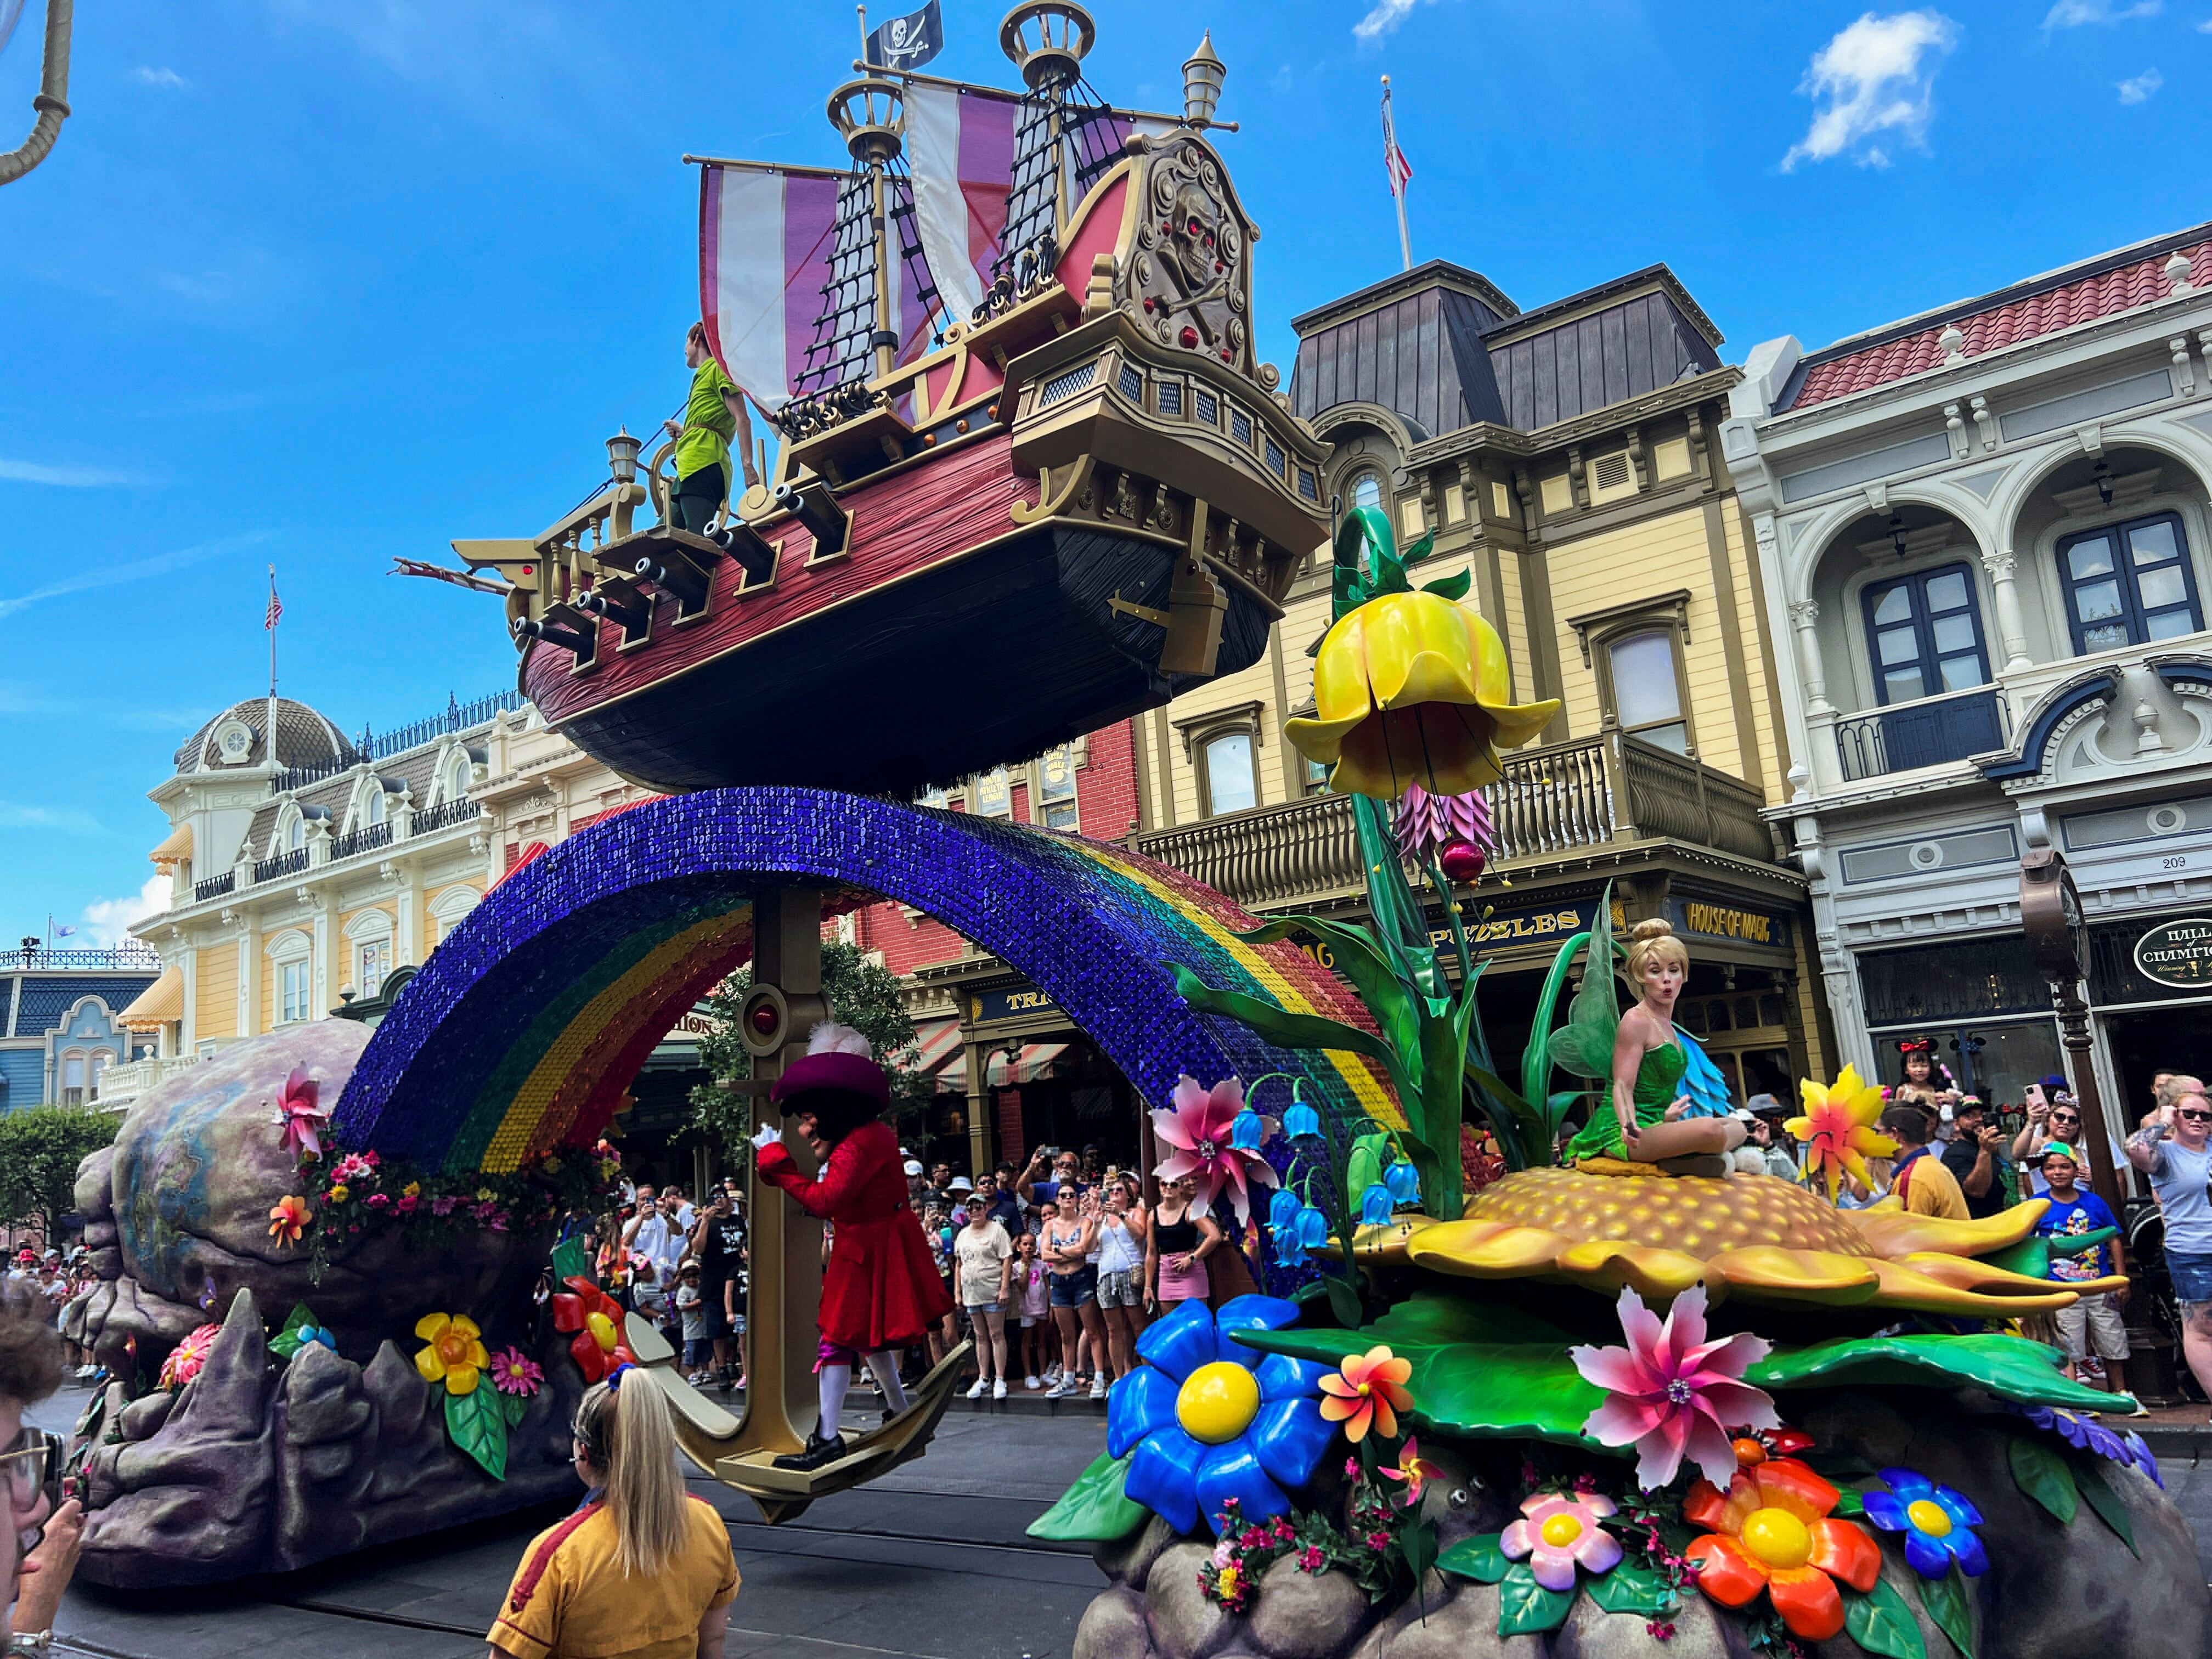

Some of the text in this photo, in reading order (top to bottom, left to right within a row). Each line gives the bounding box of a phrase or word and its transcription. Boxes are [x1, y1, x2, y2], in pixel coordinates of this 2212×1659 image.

[982, 774, 1002, 787] YOUTH
[980, 782, 1006, 795] ATHLETIC
[983, 791, 1004, 803] LEAGUE
[2163, 856, 2185, 868] 209
[1686, 903, 1770, 943] HOUSE OF MAGIC
[2167, 927, 2212, 941] HALL
[2187, 938, 2198, 948] of
[1006, 992, 1053, 1010] TRI
